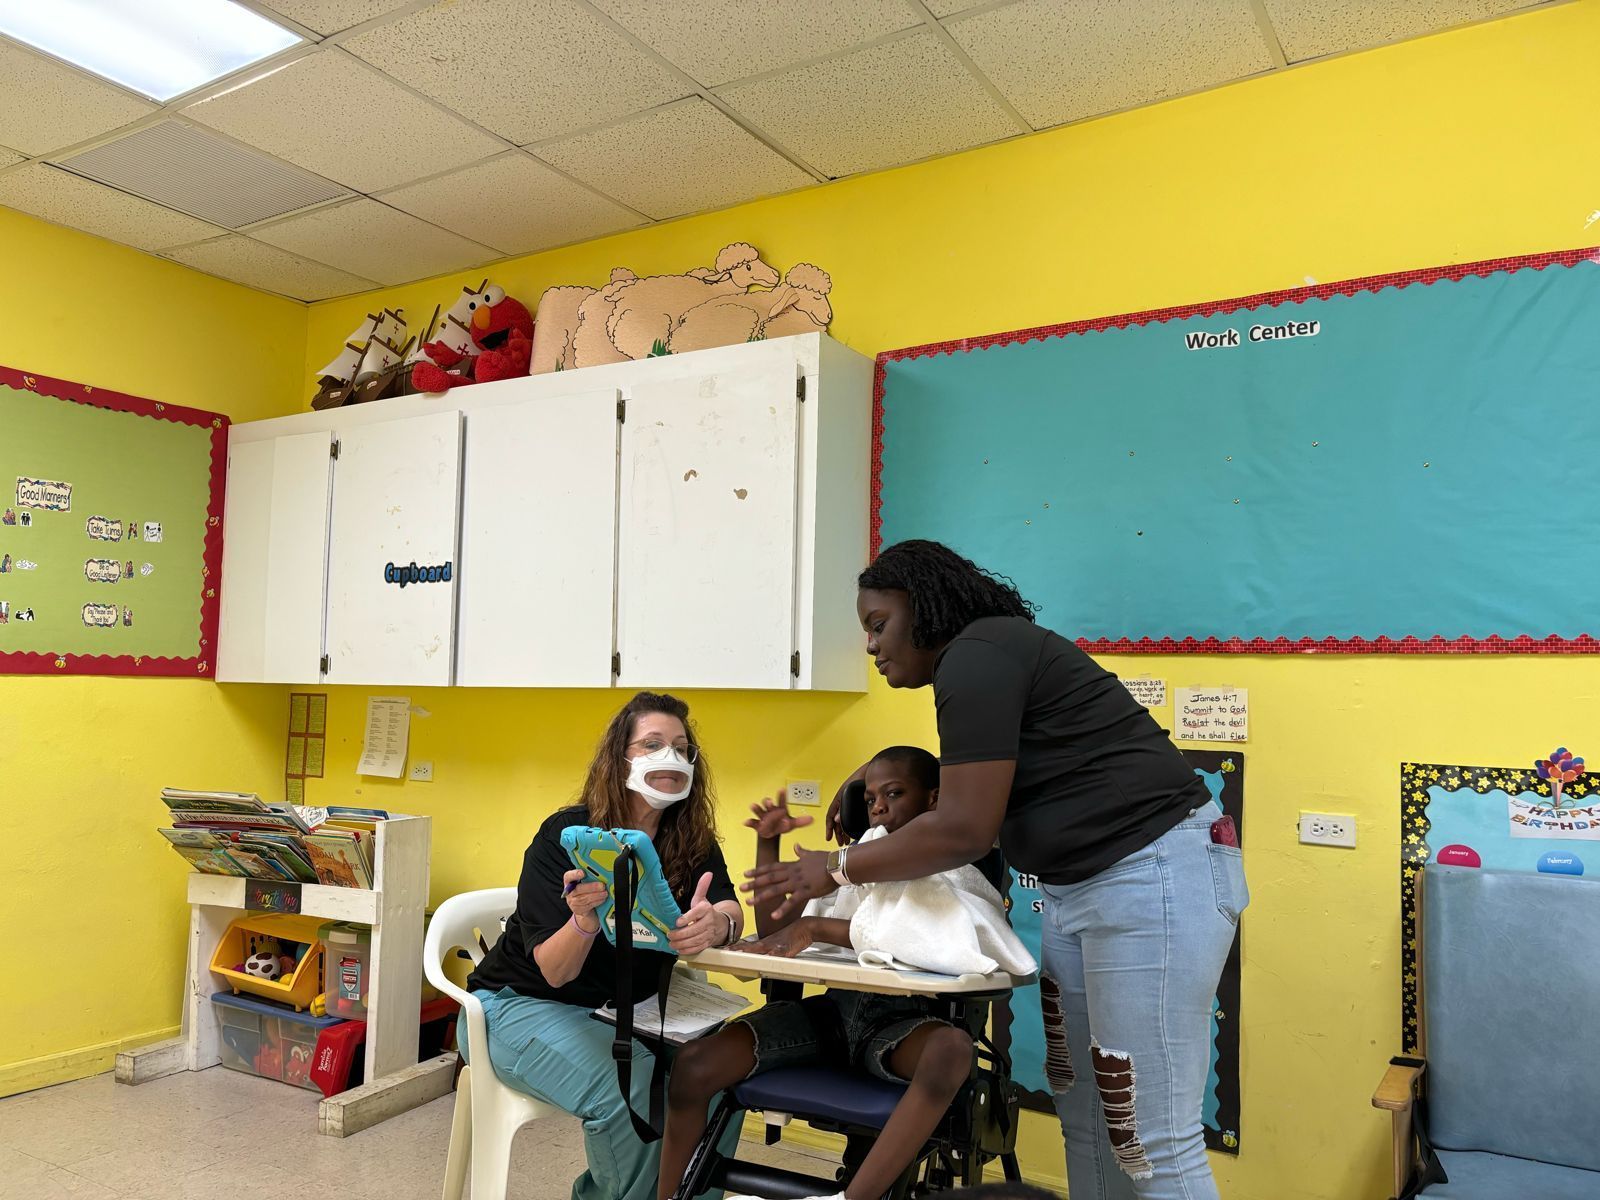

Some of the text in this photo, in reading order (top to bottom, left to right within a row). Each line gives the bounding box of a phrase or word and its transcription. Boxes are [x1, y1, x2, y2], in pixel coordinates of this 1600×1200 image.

[1186, 320, 1318, 349] Work Center
[20, 485, 68, 504] Good Manners
[90, 522, 120, 536] Take Turns
[384, 561, 452, 588] Cupboard
[1190, 694, 1238, 702] James 4:7
[1183, 705, 1214, 714] Summit
[1217, 705, 1227, 713] to
[1182, 717, 1246, 727] Resist the devil
[1180, 731, 1195, 740] and
[1197, 731, 1207, 740] he
[1208, 731, 1226, 740] shall
[1528, 806, 1594, 819] HAPPY
[1448, 849, 1469, 857] January
[1546, 857, 1573, 865] February
